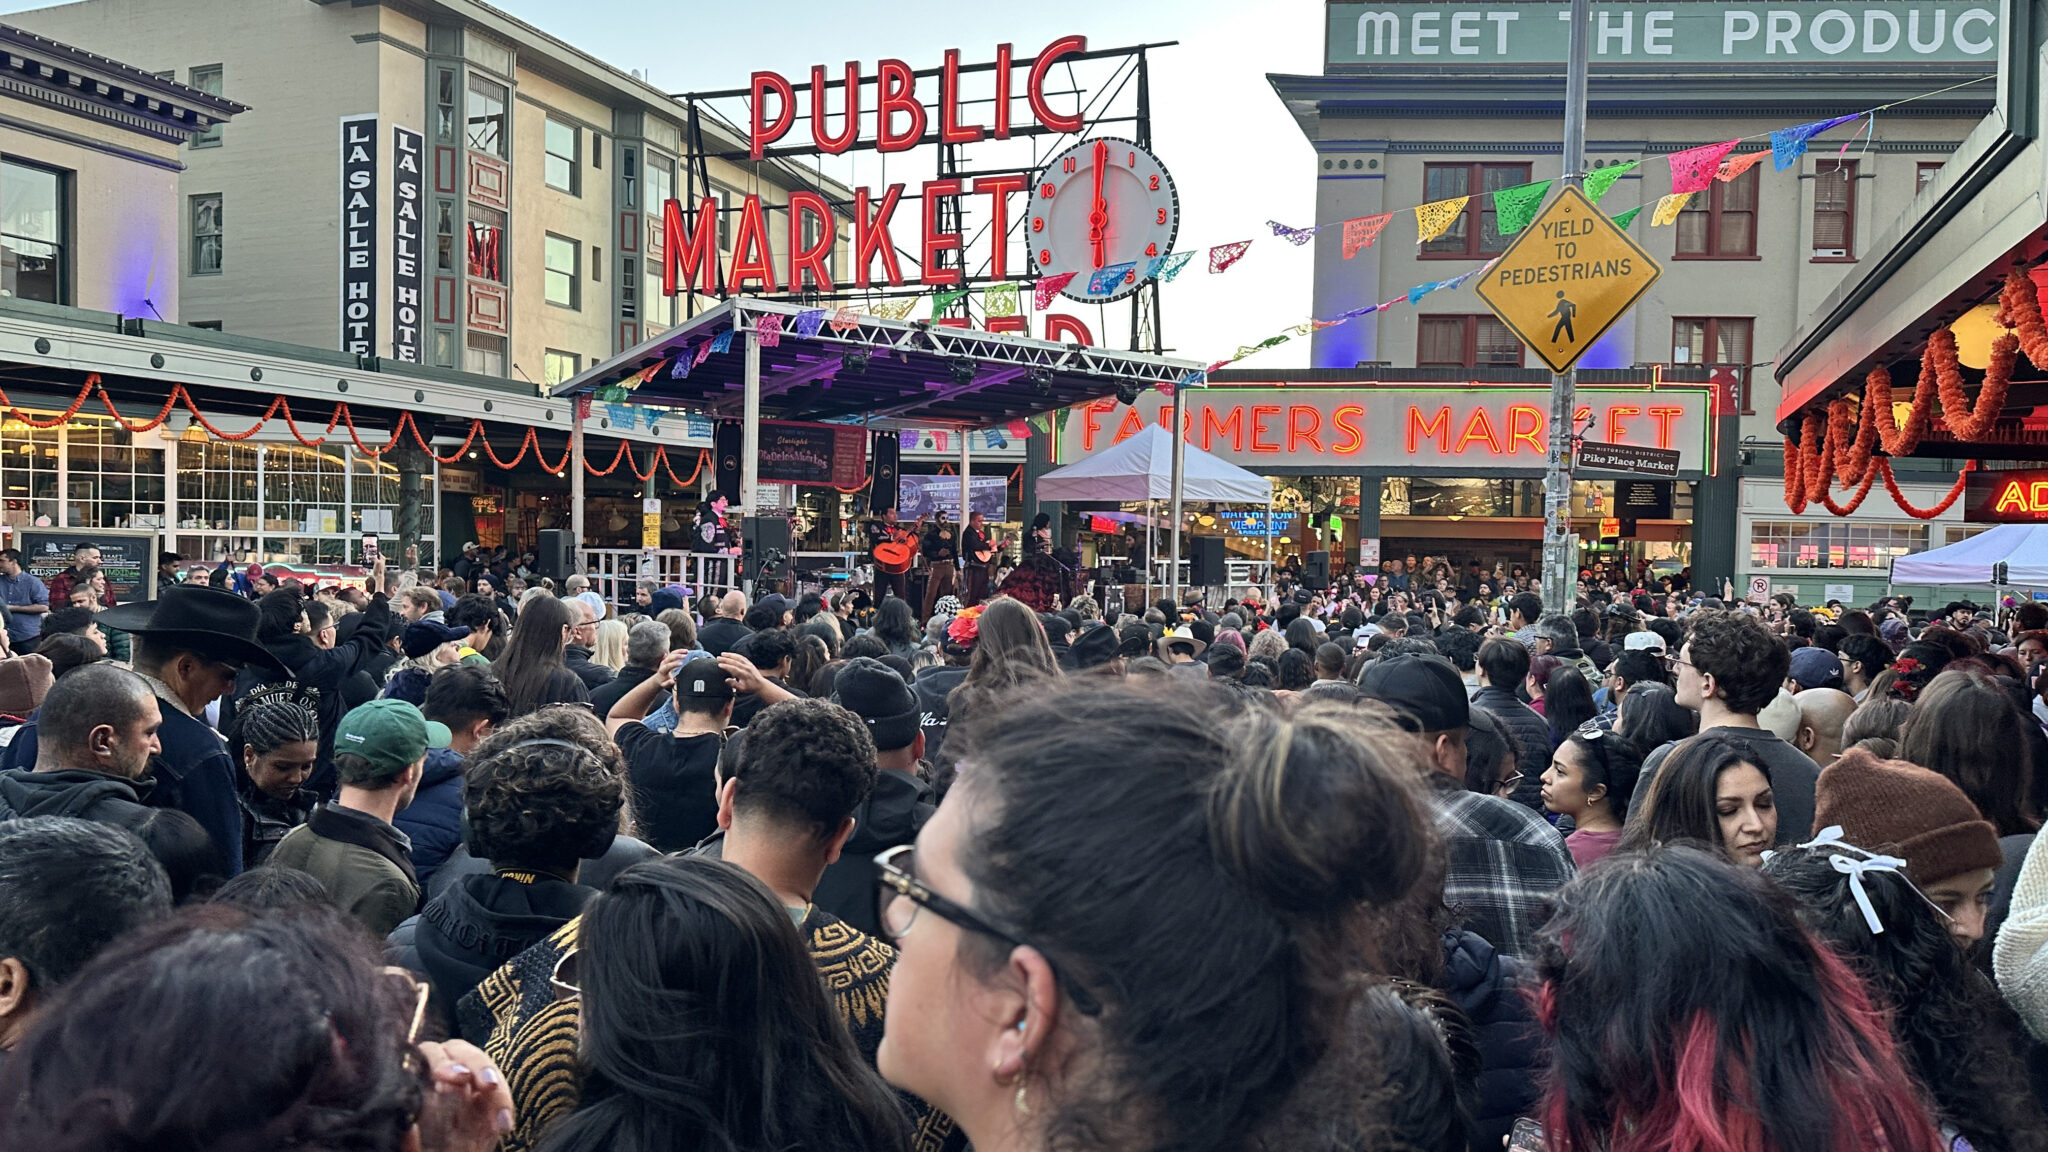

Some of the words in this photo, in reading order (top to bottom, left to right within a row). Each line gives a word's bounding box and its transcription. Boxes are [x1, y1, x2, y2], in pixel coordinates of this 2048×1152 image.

[1357, 11, 1519, 55] MEET
[750, 35, 1087, 161] PUBLIC
[347, 126, 371, 164] LA
[398, 132, 418, 174] LA
[1063, 157, 1076, 173] 11
[1129, 152, 1135, 168] 1
[1041, 183, 1056, 199] 10
[1149, 175, 1159, 191] 2
[347, 170, 371, 268] SALLE
[1032, 216, 1044, 232] 9
[1156, 208, 1167, 224] 3
[398, 181, 417, 278] SALLE
[663, 174, 1031, 297] MARKET
[1541, 218, 1594, 239] YIELD
[1039, 249, 1051, 265] 8
[1145, 242, 1158, 258] 4
[1555, 242, 1577, 260] TO
[1500, 258, 1632, 287] PEDESTRIANS
[347, 281, 369, 358] HOTE
[398, 285, 418, 363] HOTE
[1408, 405, 1683, 454] MARET
[1596, 447, 1633, 455] HISTORICAL
[1583, 453, 1606, 464] Pike
[1607, 456, 1635, 467] Place
[1636, 459, 1675, 471] Market
[285, 680, 299, 689] DE
[259, 692, 316, 710] MUEROS
[502, 872, 536, 884] Nikon
